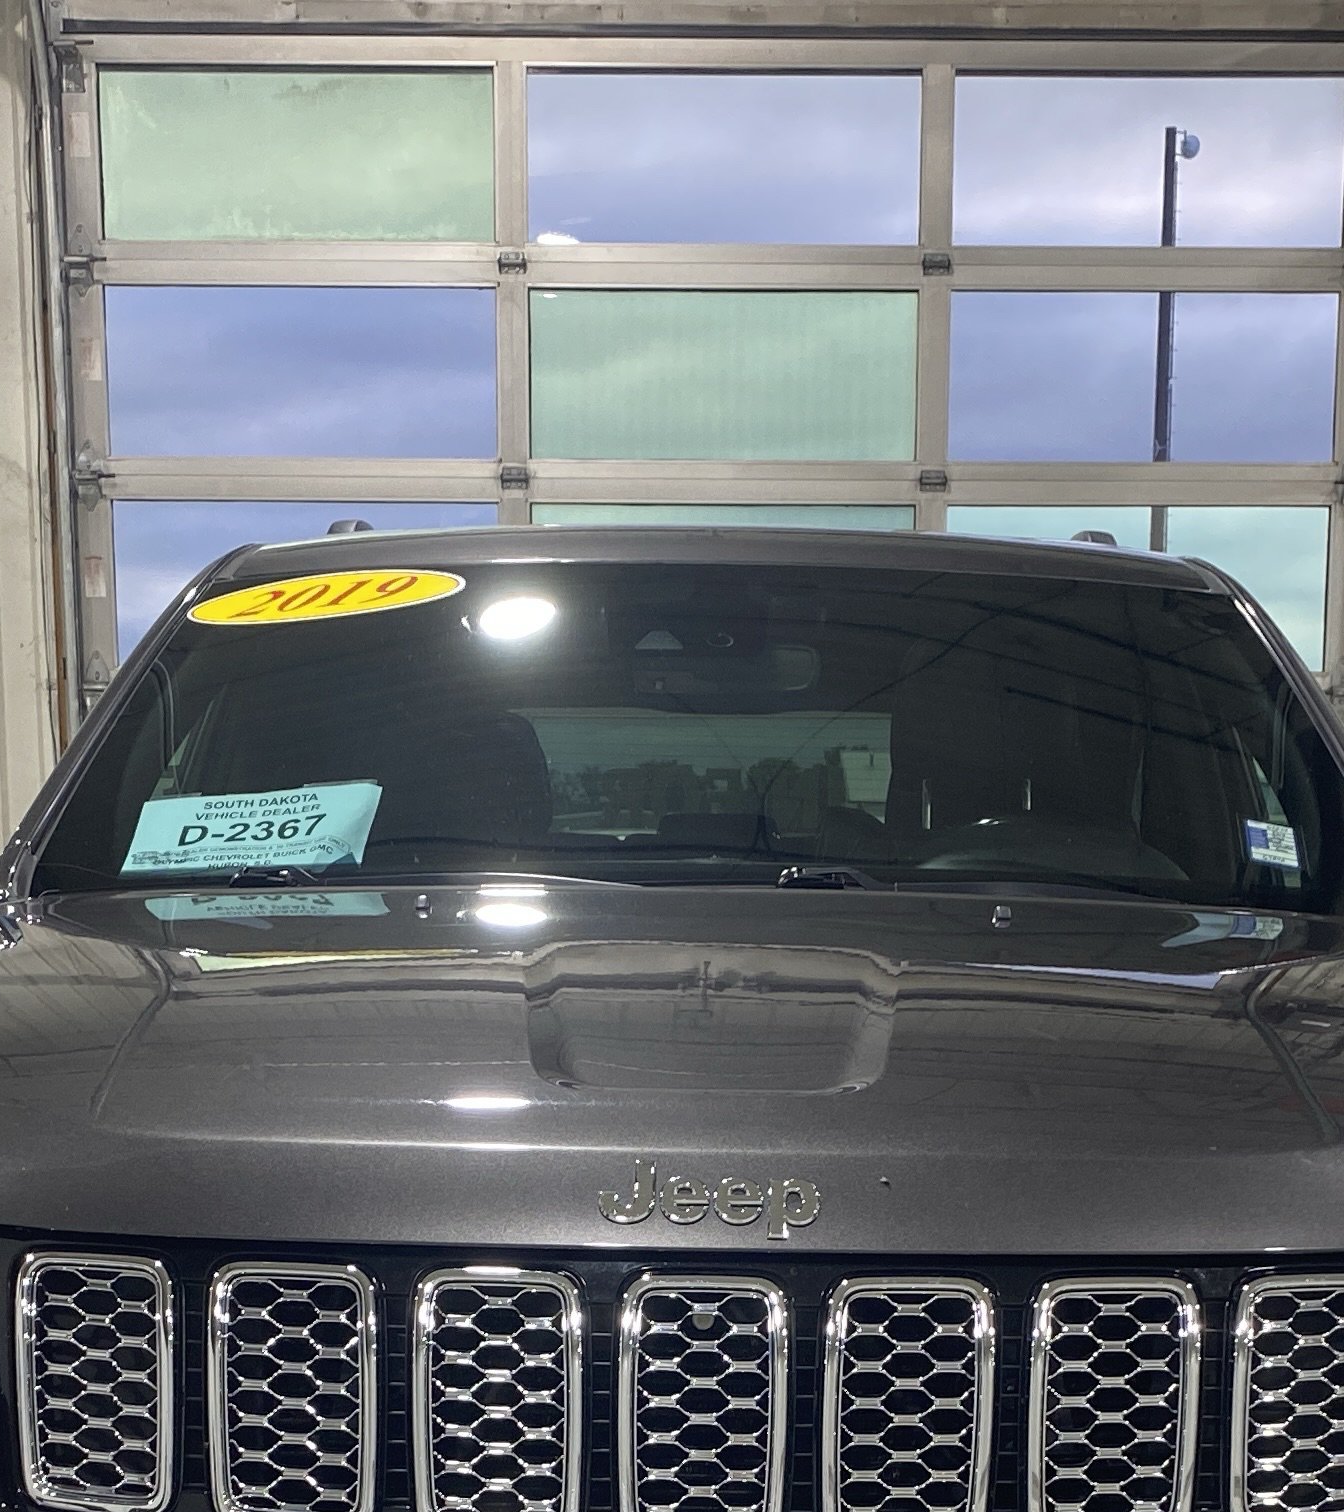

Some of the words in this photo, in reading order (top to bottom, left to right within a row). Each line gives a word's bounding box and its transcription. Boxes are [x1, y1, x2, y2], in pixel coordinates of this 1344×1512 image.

[228, 575, 419, 619] 2019
[196, 811, 257, 820] VEHICLE
[262, 804, 321, 816] DEALER
[204, 799, 254, 810] SOUTH
[259, 794, 318, 807] DAKOTA
[178, 813, 326, 846] D-2367
[204, 853, 269, 861] CHEVROLET
[273, 849, 307, 857] BUICK
[310, 844, 334, 855] GMC
[598, 1159, 821, 1240] Jeep
